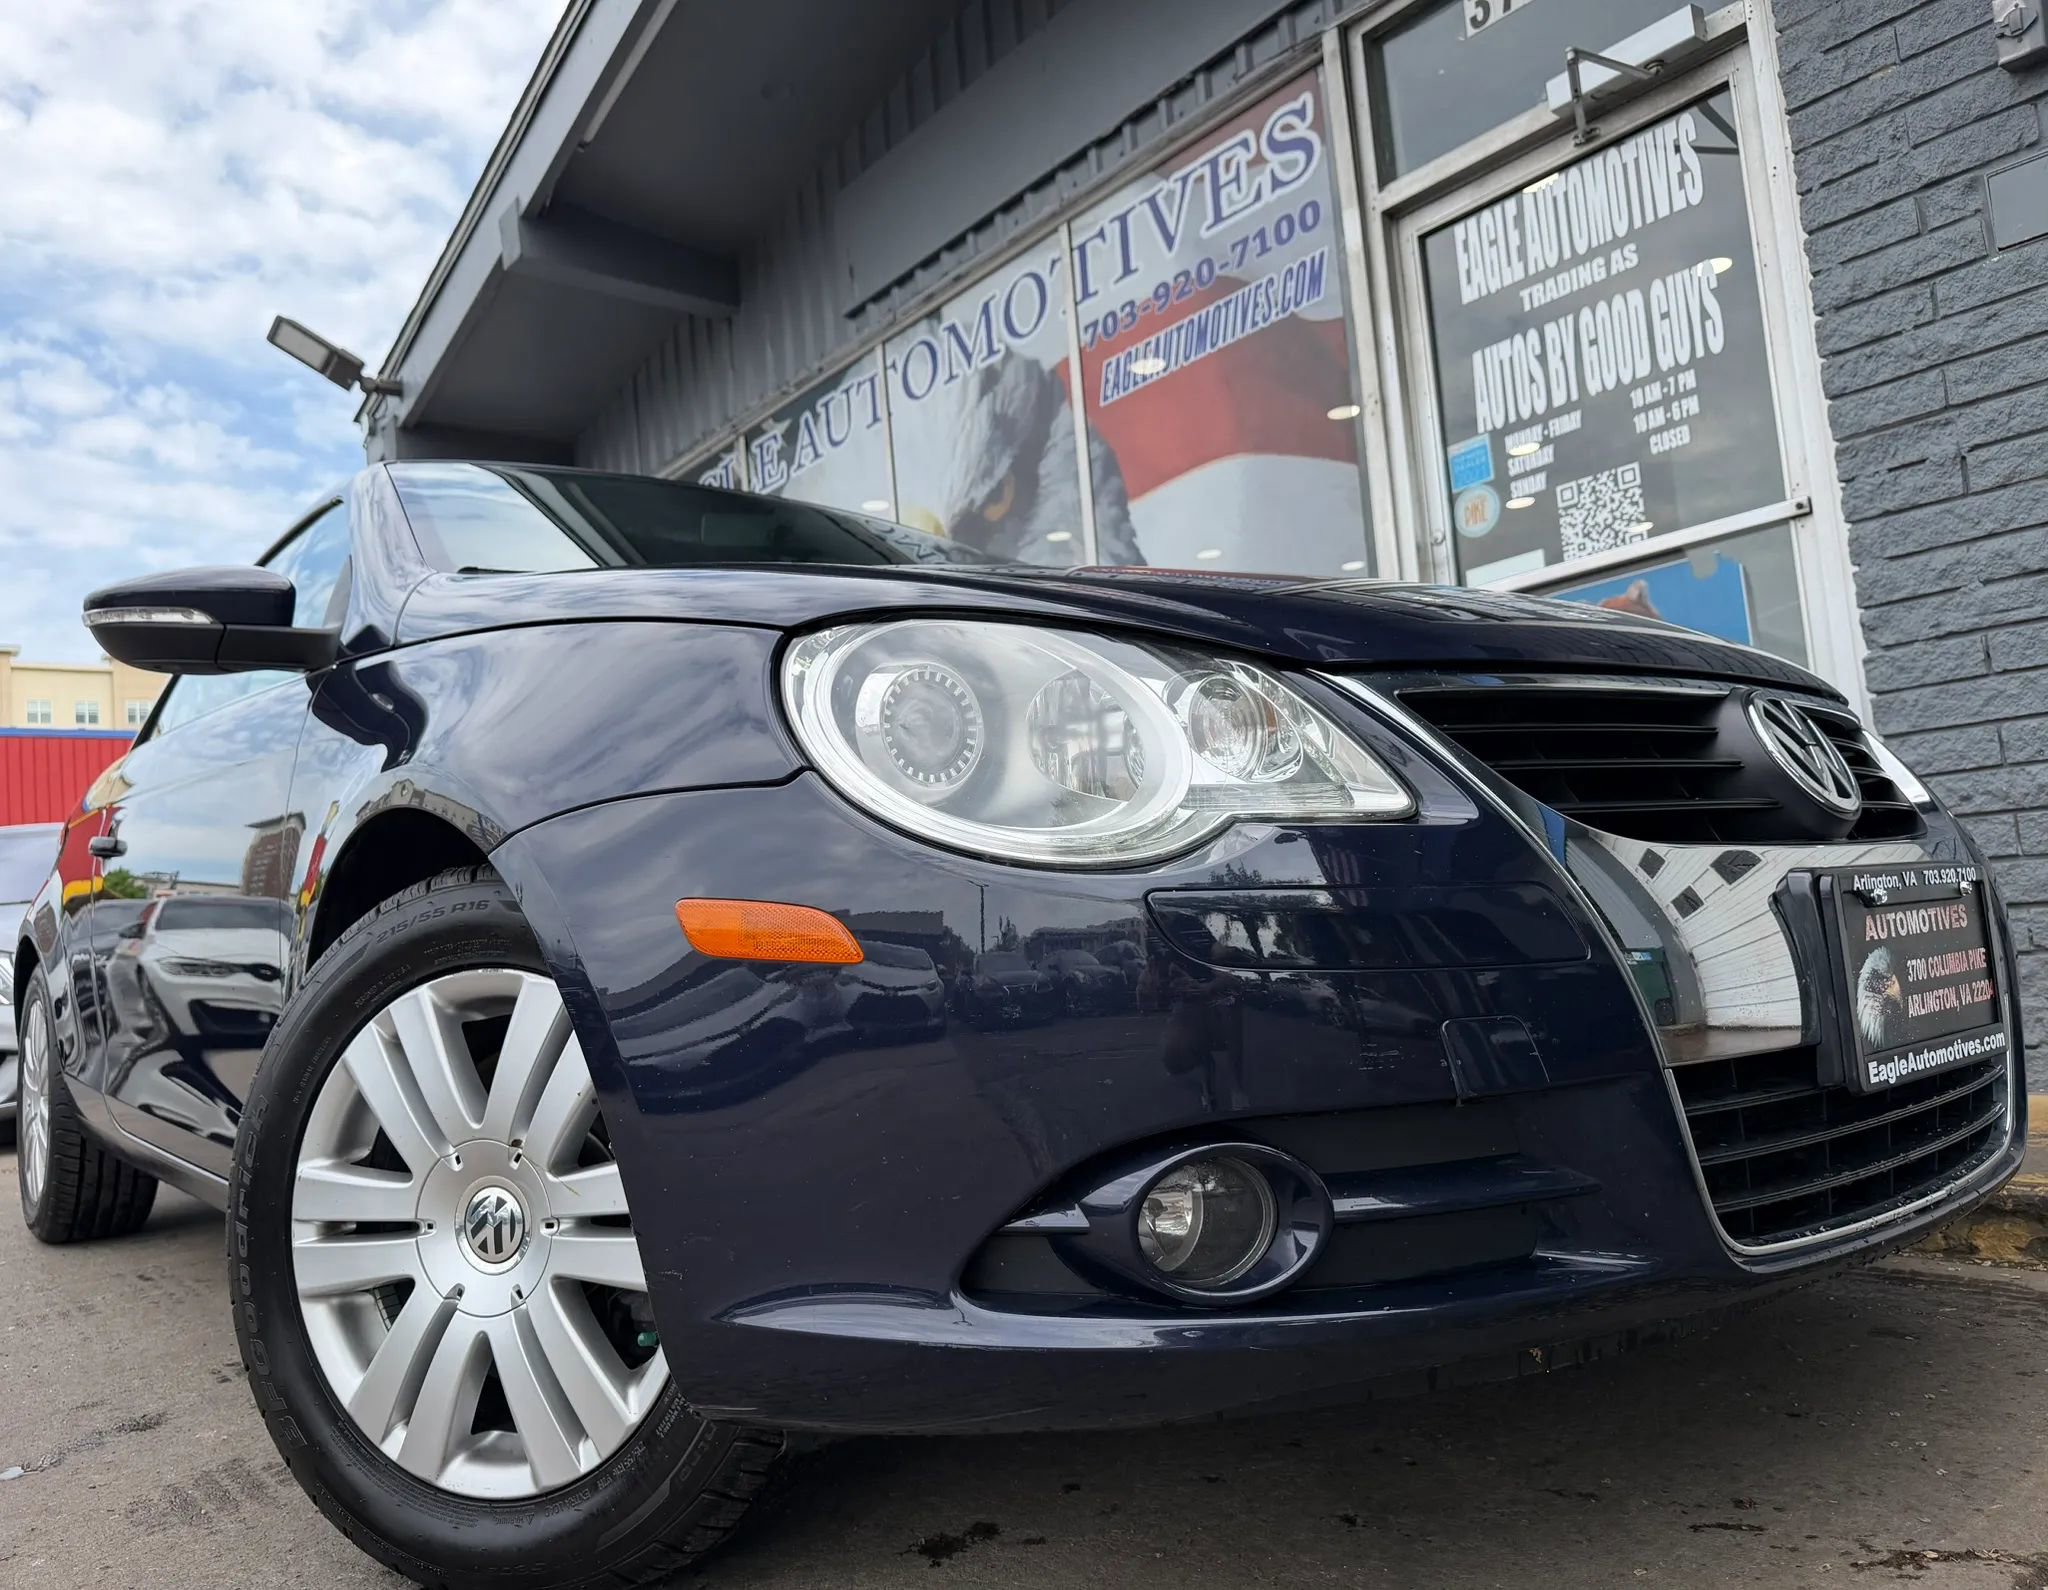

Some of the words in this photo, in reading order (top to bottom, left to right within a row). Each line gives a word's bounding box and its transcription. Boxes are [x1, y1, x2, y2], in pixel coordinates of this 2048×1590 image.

[1453, 195, 1525, 305] EAGLE
[1522, 112, 1703, 277] AUTOMOTIVES
[790, 96, 1318, 474] AUTOMOTIVES
[1083, 199, 1322, 350] 703-920-7100
[1519, 256, 1607, 313] TRADING
[1610, 243, 1640, 276] AS
[1101, 248, 1327, 405] EAGLEAUTOMOTIVES.COM
[1472, 328, 1548, 433] AUTOS
[1544, 313, 1580, 409] BY
[1579, 288, 1651, 397] GOOD
[1650, 259, 1725, 372] GUYS
[1629, 387, 1644, 409] 10
[1644, 380, 1663, 405] AM
[1677, 368, 1697, 393] PM
[1504, 423, 1543, 454] MONDAY
[1548, 408, 1582, 439] FRIDAY
[1633, 411, 1648, 434] 10
[1647, 405, 1666, 430] AM
[1681, 394, 1700, 418] PM
[1507, 443, 1555, 478] SATURDAY
[1649, 424, 1691, 455] CLOSED
[1510, 471, 1547, 499] SUNDAY
[1853, 873, 1902, 891] Arlington,
[1902, 870, 1918, 887] VA
[1922, 867, 1977, 886] 703.920.7100
[376, 906, 446, 945] 215/55
[450, 900, 490, 915] R16
[1864, 903, 1969, 942] AUTOMOTIVES
[1906, 957, 1928, 982] 3700
[1927, 950, 1969, 979] COLUMBIA
[1968, 947, 1988, 971] PIKE
[1908, 986, 1961, 1018] ARLINGTON,
[1959, 983, 1974, 1006] VA
[1972, 978, 1995, 1004] 22204
[1867, 1031, 2006, 1084] EagleAutomotives.com
